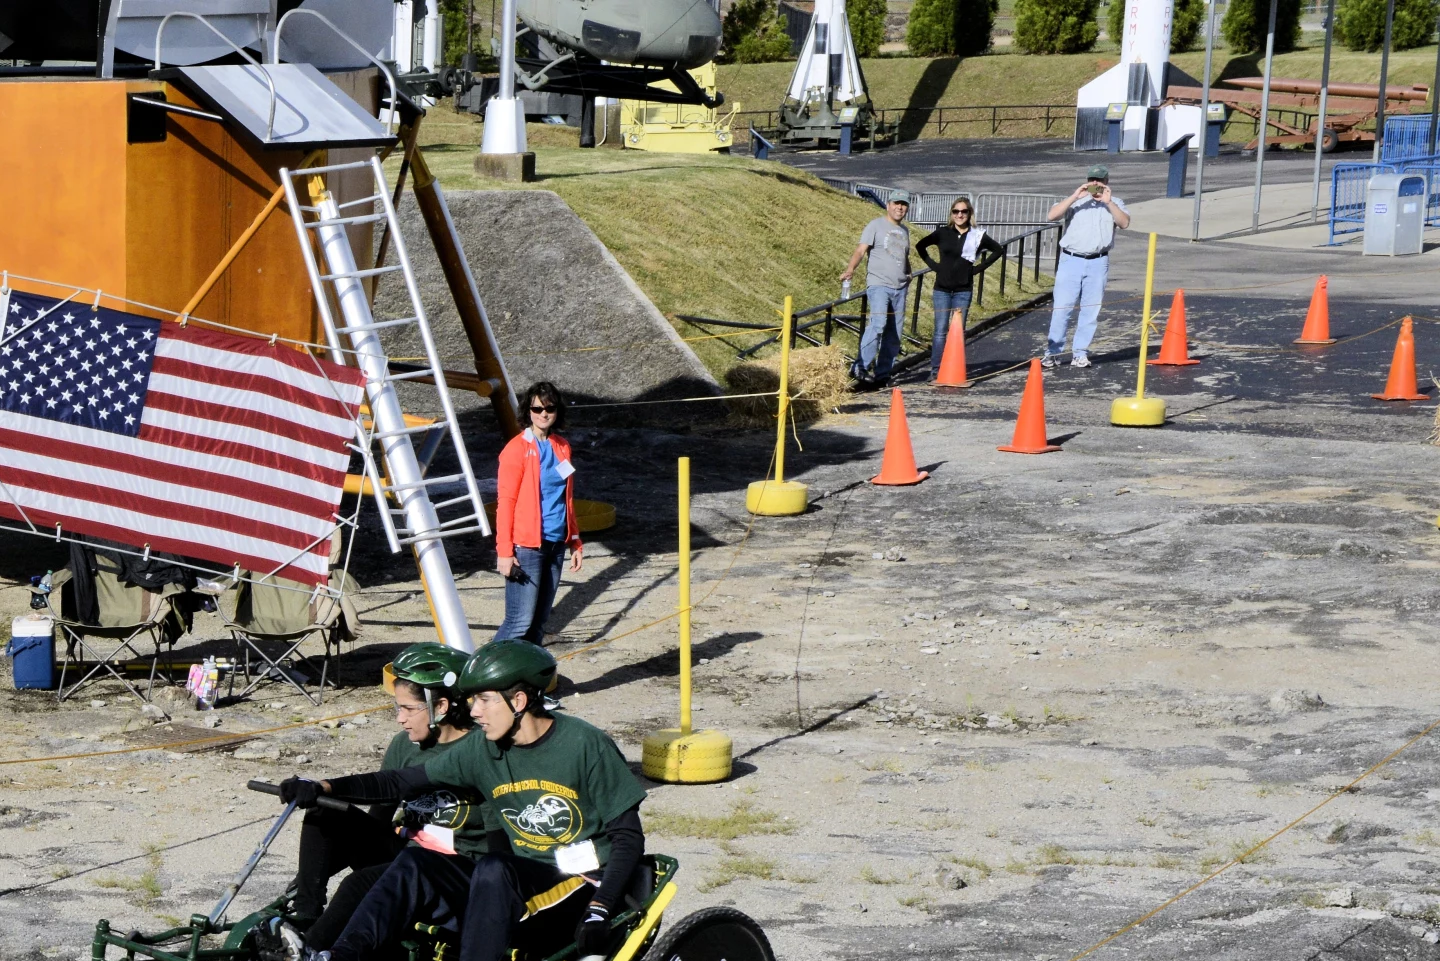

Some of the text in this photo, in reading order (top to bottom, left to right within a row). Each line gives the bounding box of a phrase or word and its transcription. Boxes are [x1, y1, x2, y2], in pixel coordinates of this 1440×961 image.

[1128, 0, 1139, 52] RMY
[1162, 0, 1171, 50] RMY
[521, 779, 540, 791] SCHOOL
